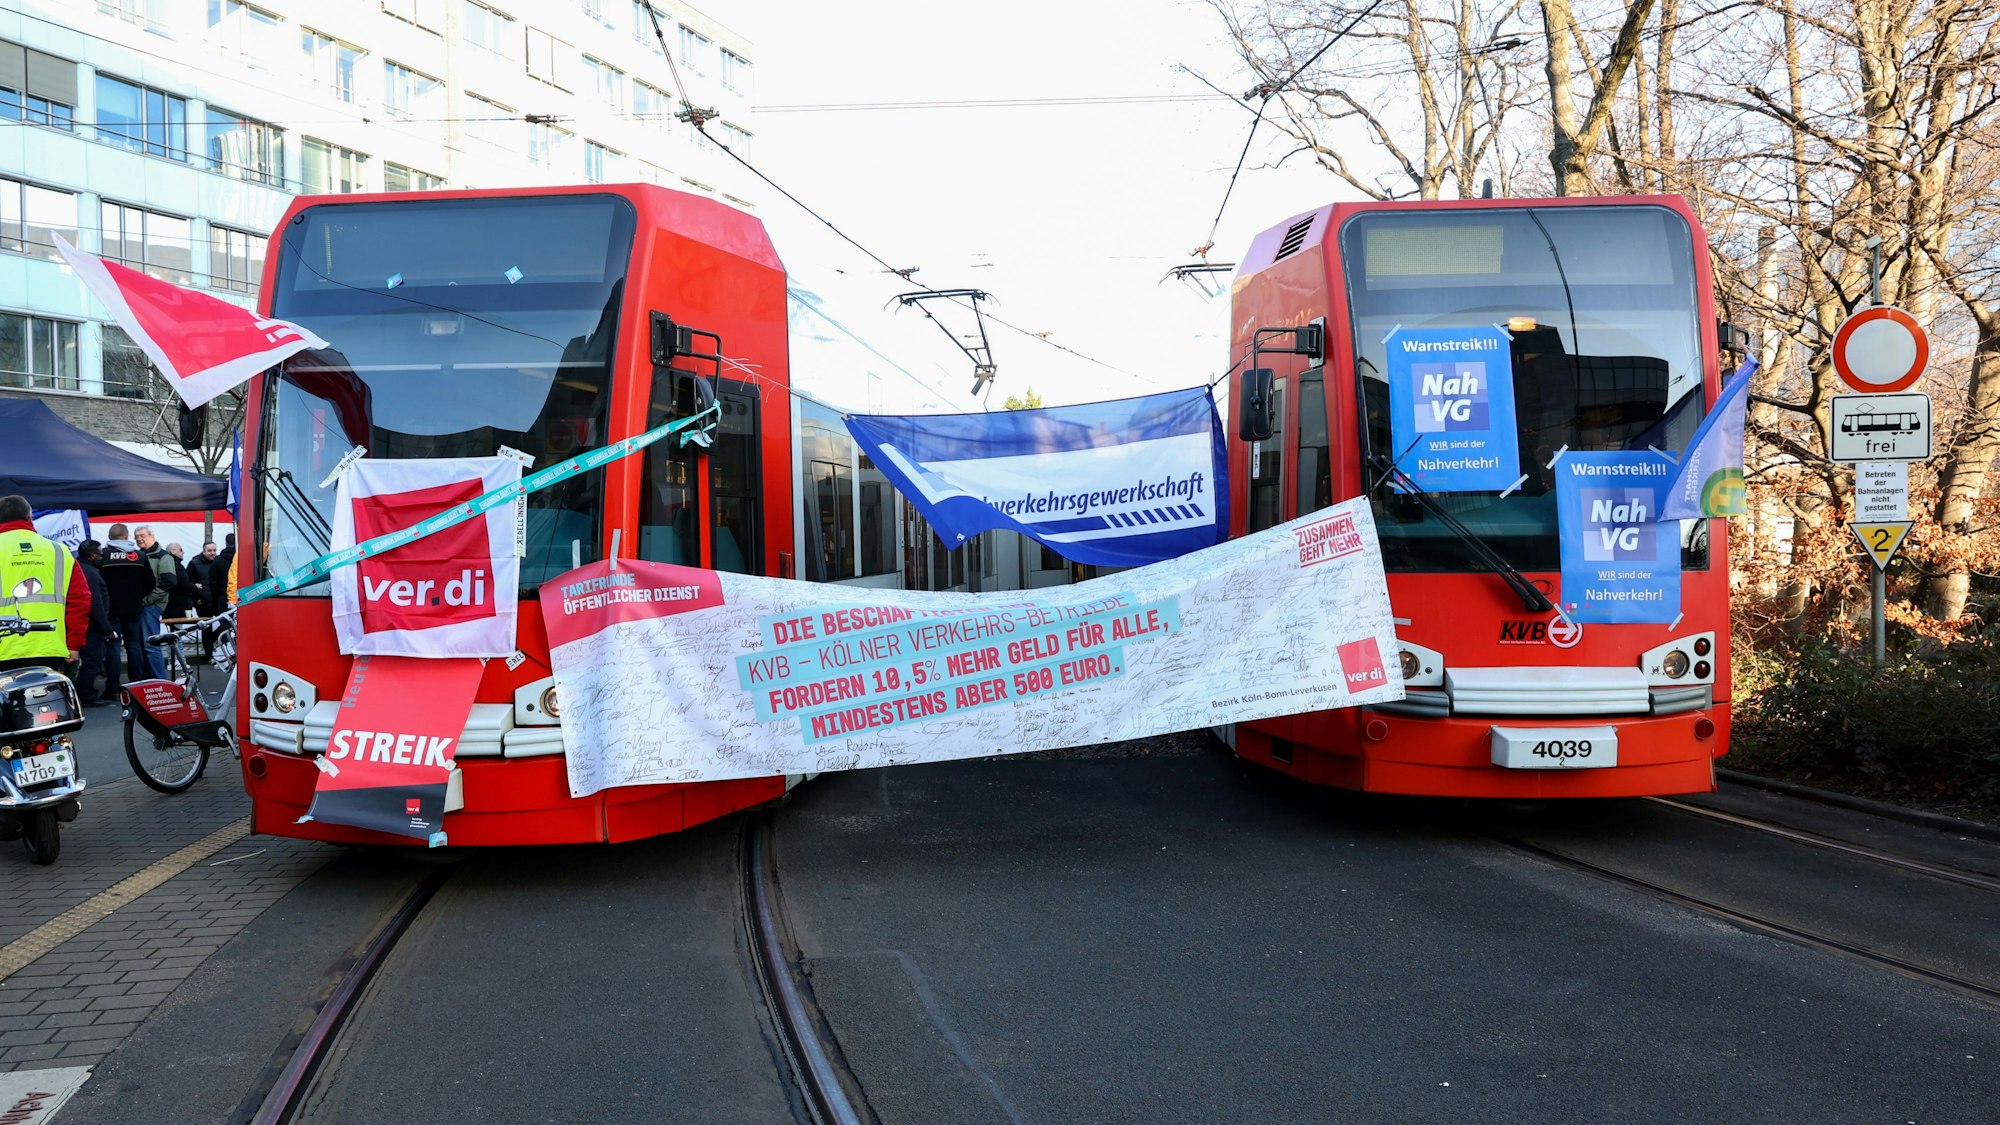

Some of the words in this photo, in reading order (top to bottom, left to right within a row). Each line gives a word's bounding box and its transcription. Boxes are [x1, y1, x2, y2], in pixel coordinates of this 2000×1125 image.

[1403, 338, 1498, 352] Warnstreik!!!
[1421, 371, 1478, 396] Nah
[1431, 399, 1471, 422] VG
[1429, 440, 1448, 450] WIR
[1450, 439, 1469, 449] sind
[1470, 438, 1486, 449] der
[1866, 439, 1896, 453] frei
[1418, 456, 1499, 471] Nahverkehr!
[1571, 462, 1666, 477] Warnstreik!!!
[1865, 470, 1897, 479] Betreten
[1874, 479, 1887, 487] der
[1857, 487, 1904, 497] Bahnanlagen
[1871, 496, 1890, 504] nicht
[1590, 497, 1647, 523] Nah
[1864, 503, 1897, 512] gestattet
[1295, 516, 1355, 547] ZUSAMMEN
[1600, 526, 1640, 551] VG
[1874, 528, 1890, 552] 2
[110, 552, 126, 560] KVB
[1299, 542, 1326, 563] GEHT
[1328, 533, 1363, 555] MEHR
[1597, 570, 1616, 580] WIR
[1617, 569, 1636, 580] sind
[1637, 569, 1652, 580] der
[363, 569, 485, 606] ver.di
[561, 573, 635, 598] TARIFRUNDE
[1586, 587, 1663, 602] Nahverkehr!
[563, 588, 652, 616] ÖFFENTLICHER
[654, 585, 700, 602] DIENST
[748, 655, 791, 684] KVB
[819, 633, 902, 669] KÖLNER
[910, 595, 1129, 653] VERKEHRS-BETRIEBE
[773, 615, 815, 645] DIE
[1501, 621, 1547, 640] KVB
[769, 674, 866, 714] FORDERN
[872, 660, 942, 694] 10,5%
[948, 647, 1001, 678] MEHR
[1007, 634, 1060, 666] GELD
[1066, 621, 1106, 652] FÜR
[1112, 609, 1170, 642] ALLE,
[342, 656, 371, 708] Heute
[811, 695, 948, 739] MINDESTENS
[955, 683, 1007, 709] ABER
[1014, 667, 1054, 696] 500
[1060, 654, 1121, 686] EURO.
[1211, 695, 1240, 709] Bezirk
[1241, 683, 1338, 703] Köln-Bonn-Leverkusen
[330, 729, 454, 768] STREIK
[1532, 740, 1592, 757] 4039
[31, 758, 41, 768] L
[1559, 757, 1565, 766] 2
[18, 773, 29, 784] N
[30, 767, 56, 781] 709
